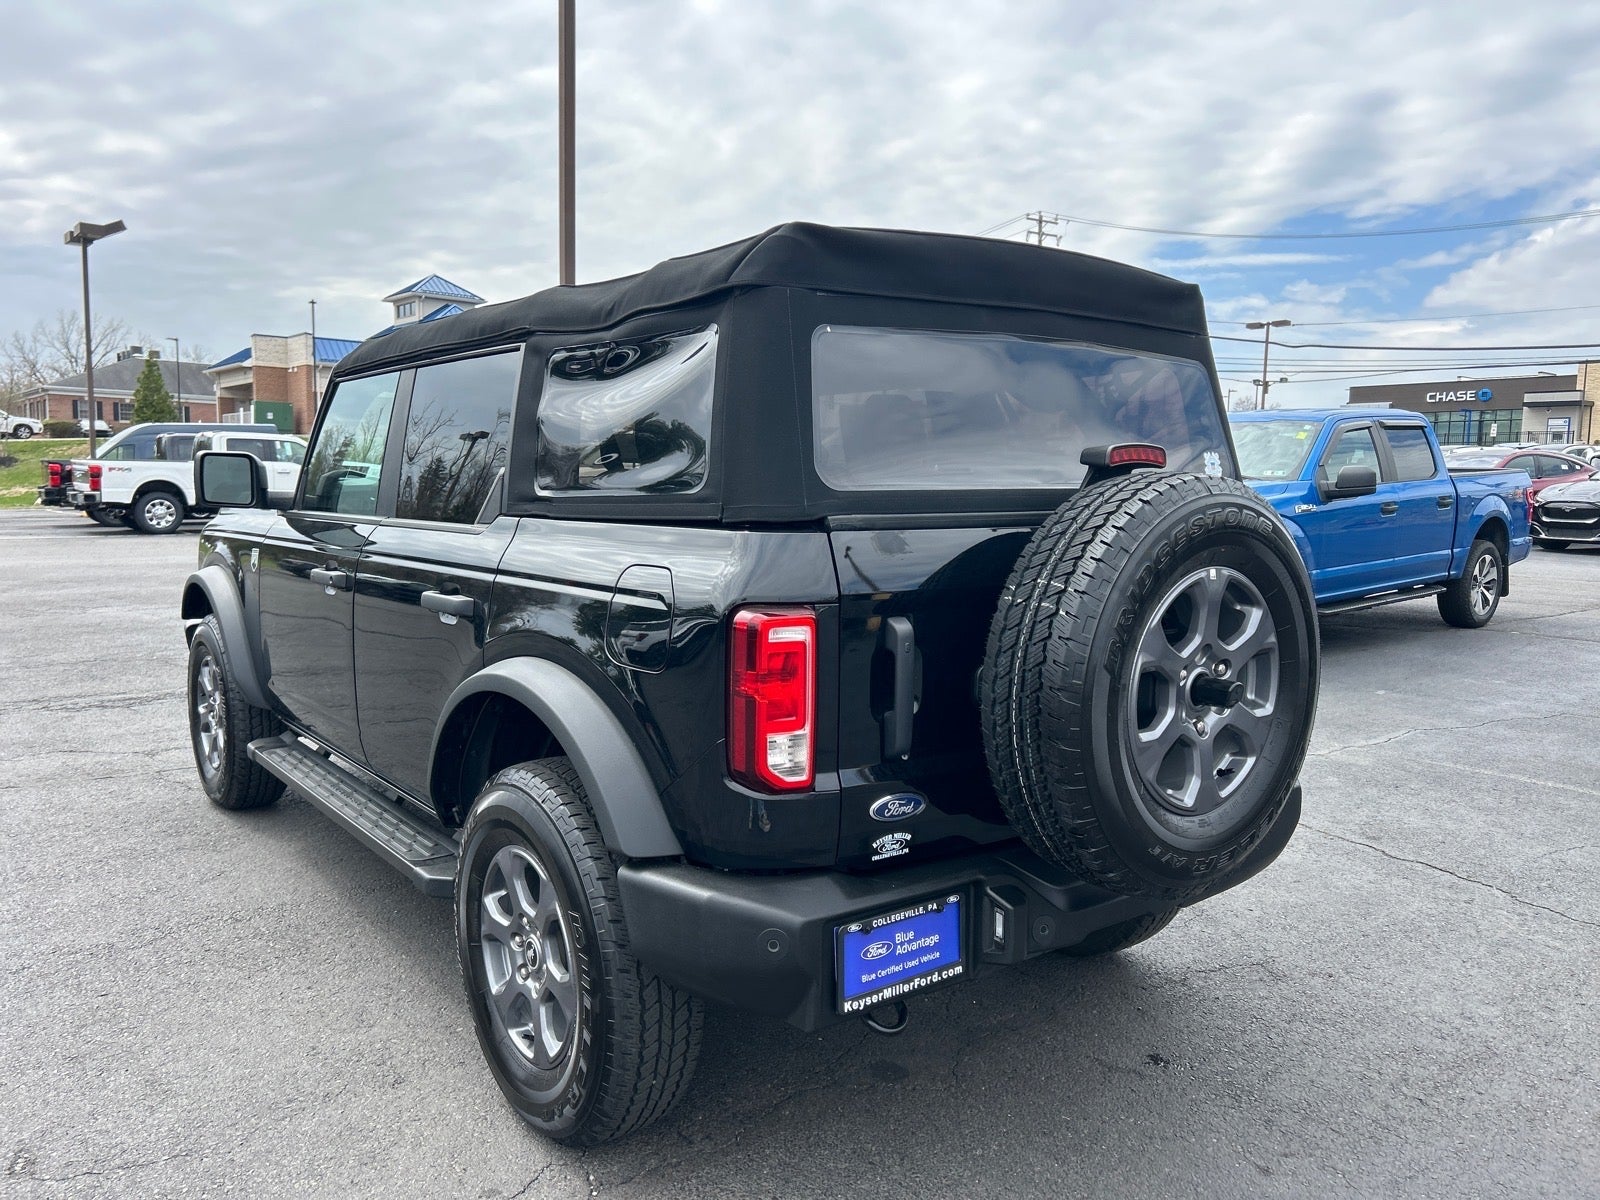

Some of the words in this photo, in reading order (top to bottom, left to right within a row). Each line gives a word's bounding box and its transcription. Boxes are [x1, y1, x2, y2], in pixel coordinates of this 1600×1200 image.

[1426, 390, 1476, 403] CHASE
[1103, 506, 1273, 671] BRIDGESTONE
[884, 799, 915, 817] Ford
[872, 834, 893, 848] KEYSER
[893, 832, 912, 841] MILLER
[882, 840, 901, 852] Ford
[872, 906, 926, 928] COLLEGEVILLE,
[927, 902, 938, 912] PA
[895, 930, 915, 943] Blue
[895, 934, 940, 956] Advantage
[867, 944, 888, 958] Ford
[861, 973, 877, 983] Blue
[877, 963, 903, 978] Certified
[904, 959, 919, 969] Used
[920, 951, 941, 963] Vehicle
[843, 965, 963, 1013] KeyserMillerFord.com
